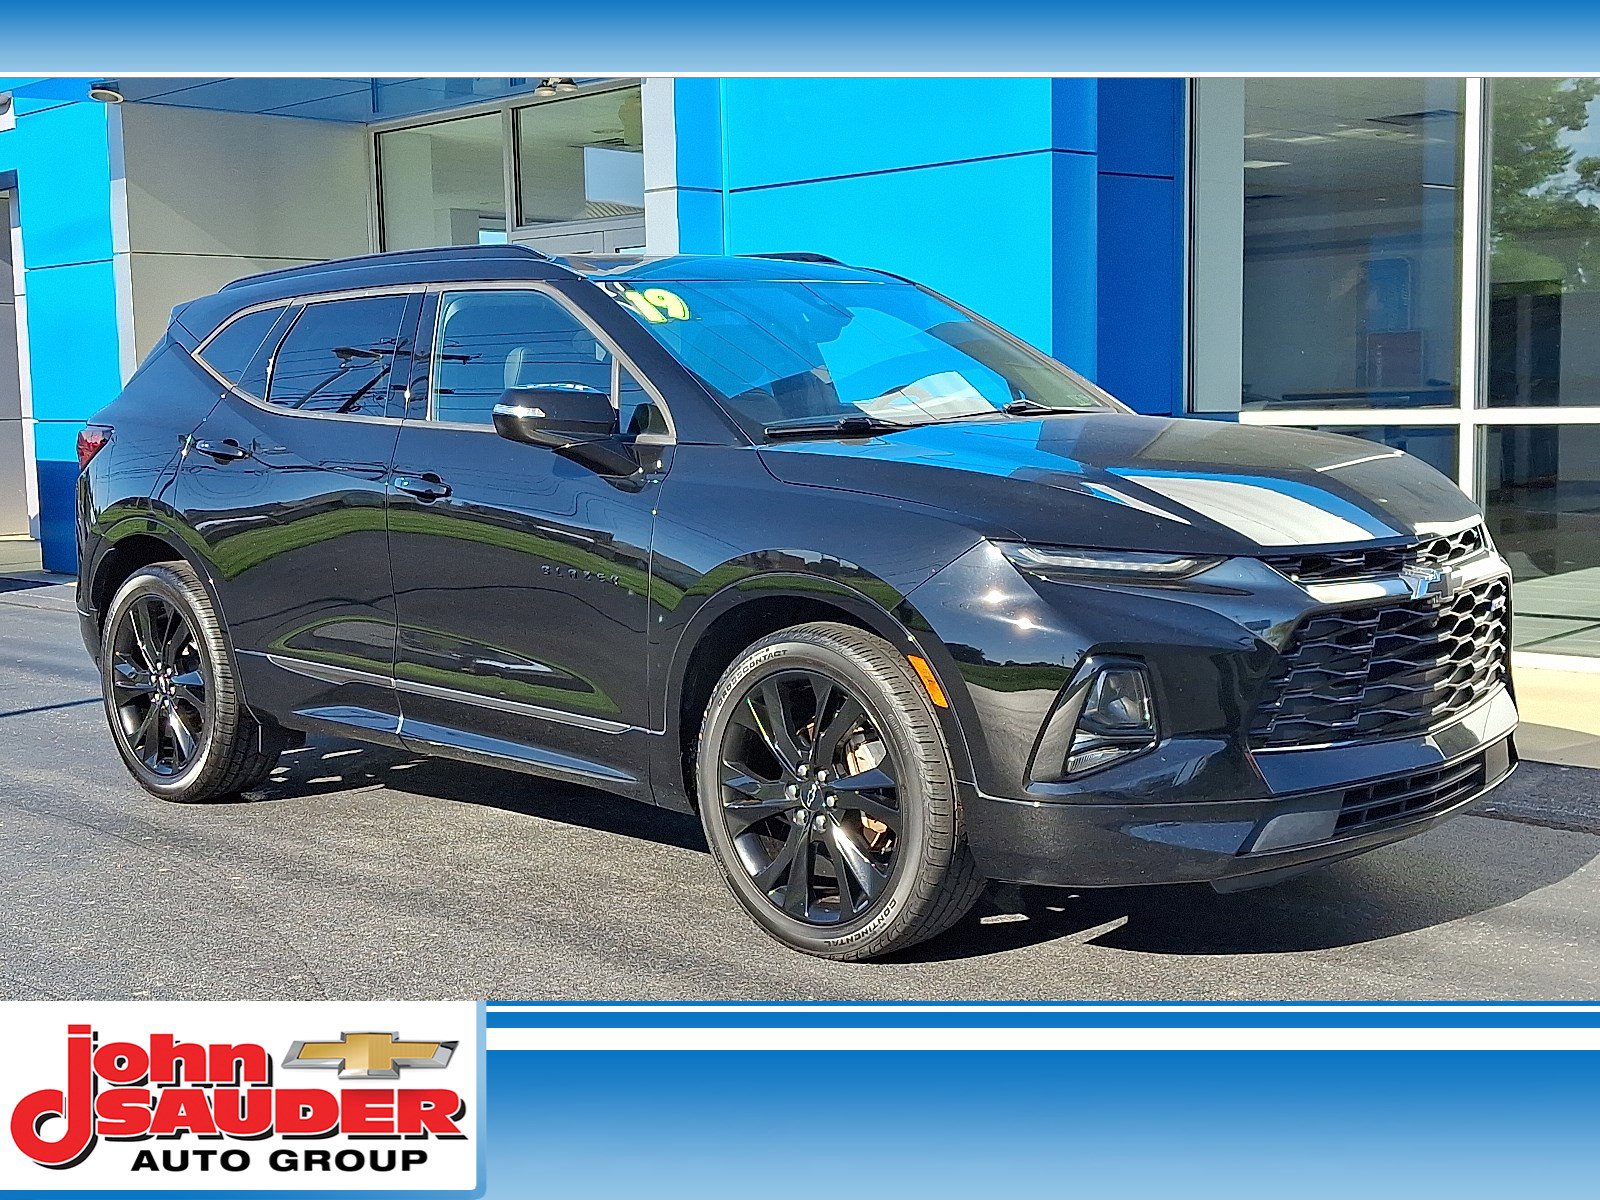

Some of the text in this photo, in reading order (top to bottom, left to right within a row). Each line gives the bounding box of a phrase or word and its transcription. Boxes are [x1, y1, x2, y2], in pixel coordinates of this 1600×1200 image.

[541, 564, 620, 586] BLAZER
[718, 649, 788, 708] CROSSCONTACT
[823, 898, 897, 947] CONTINENTAL
